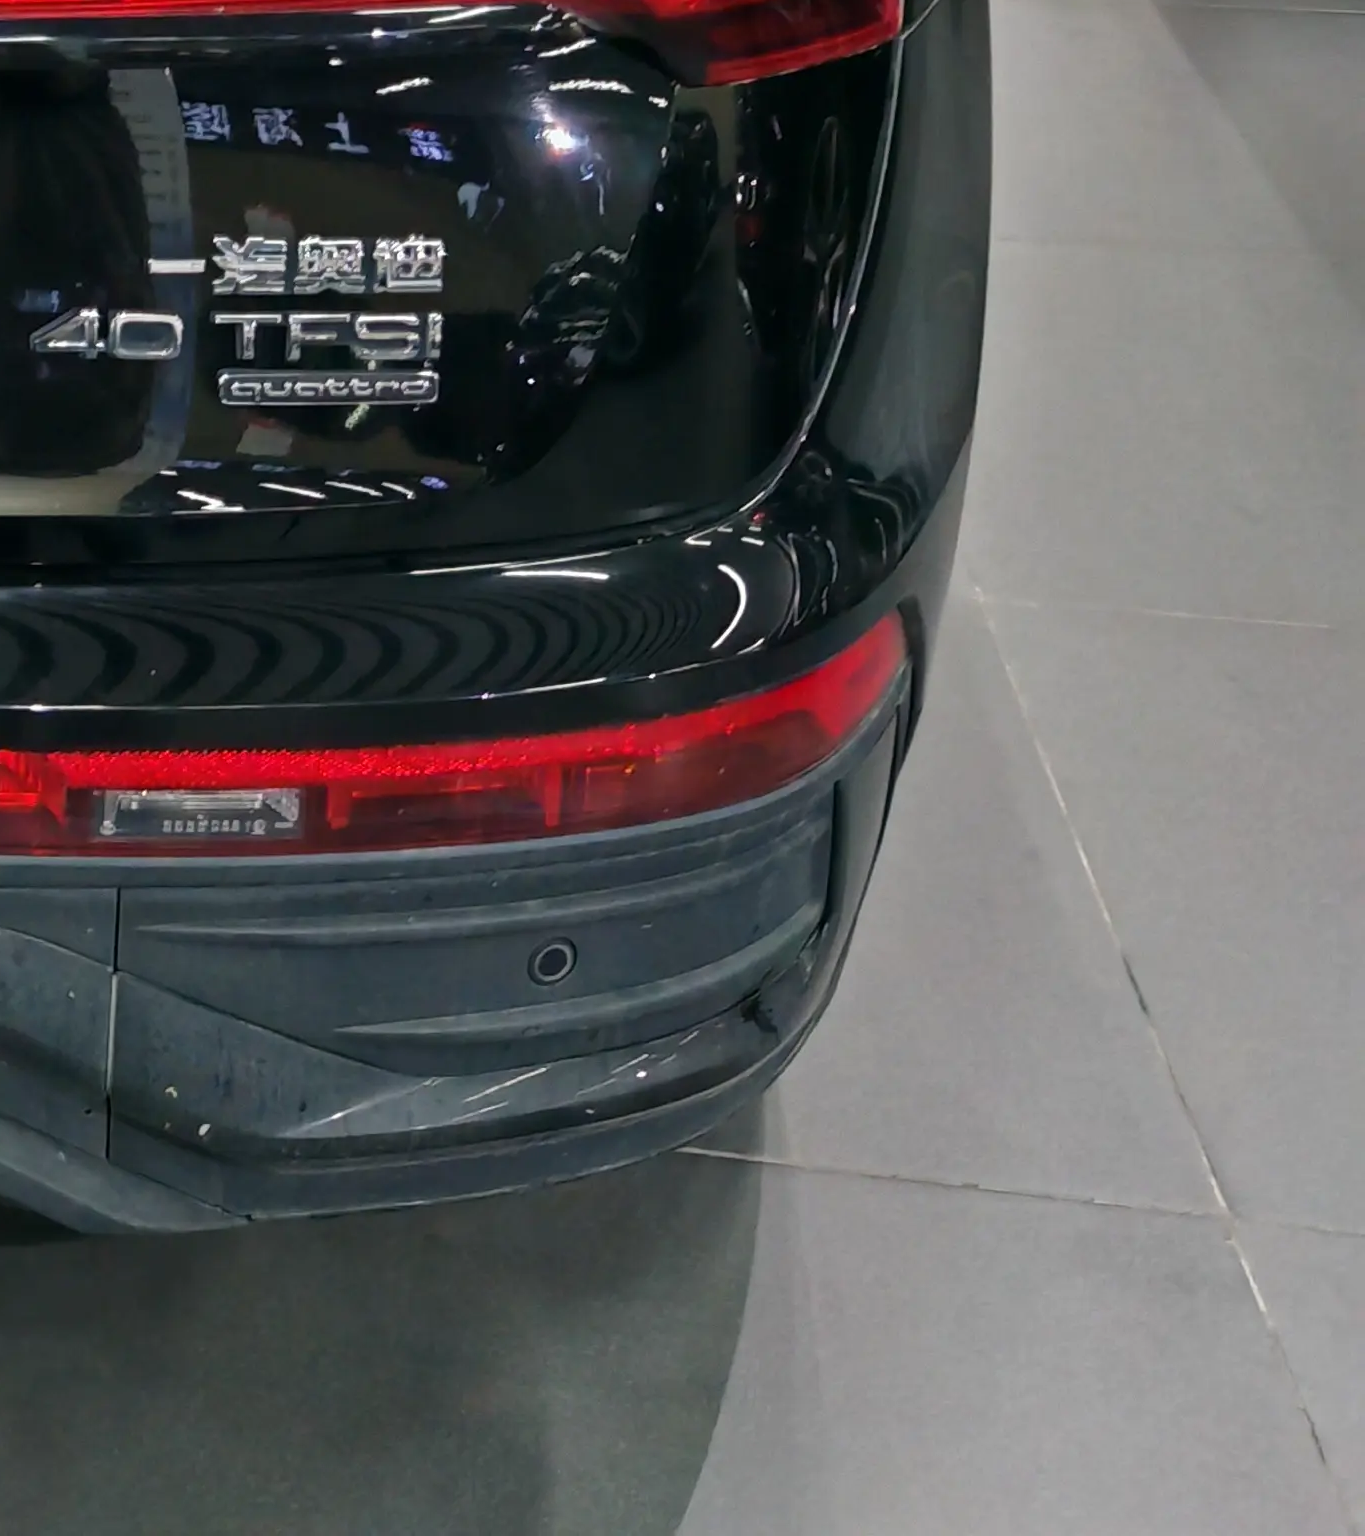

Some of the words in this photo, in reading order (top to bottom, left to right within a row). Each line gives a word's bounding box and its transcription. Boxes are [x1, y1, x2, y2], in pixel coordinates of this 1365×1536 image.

[147, 234, 447, 295] 一汽奥迪
[29, 307, 185, 360] 40
[212, 311, 444, 362] TFSI
[228, 377, 433, 402] quattro
